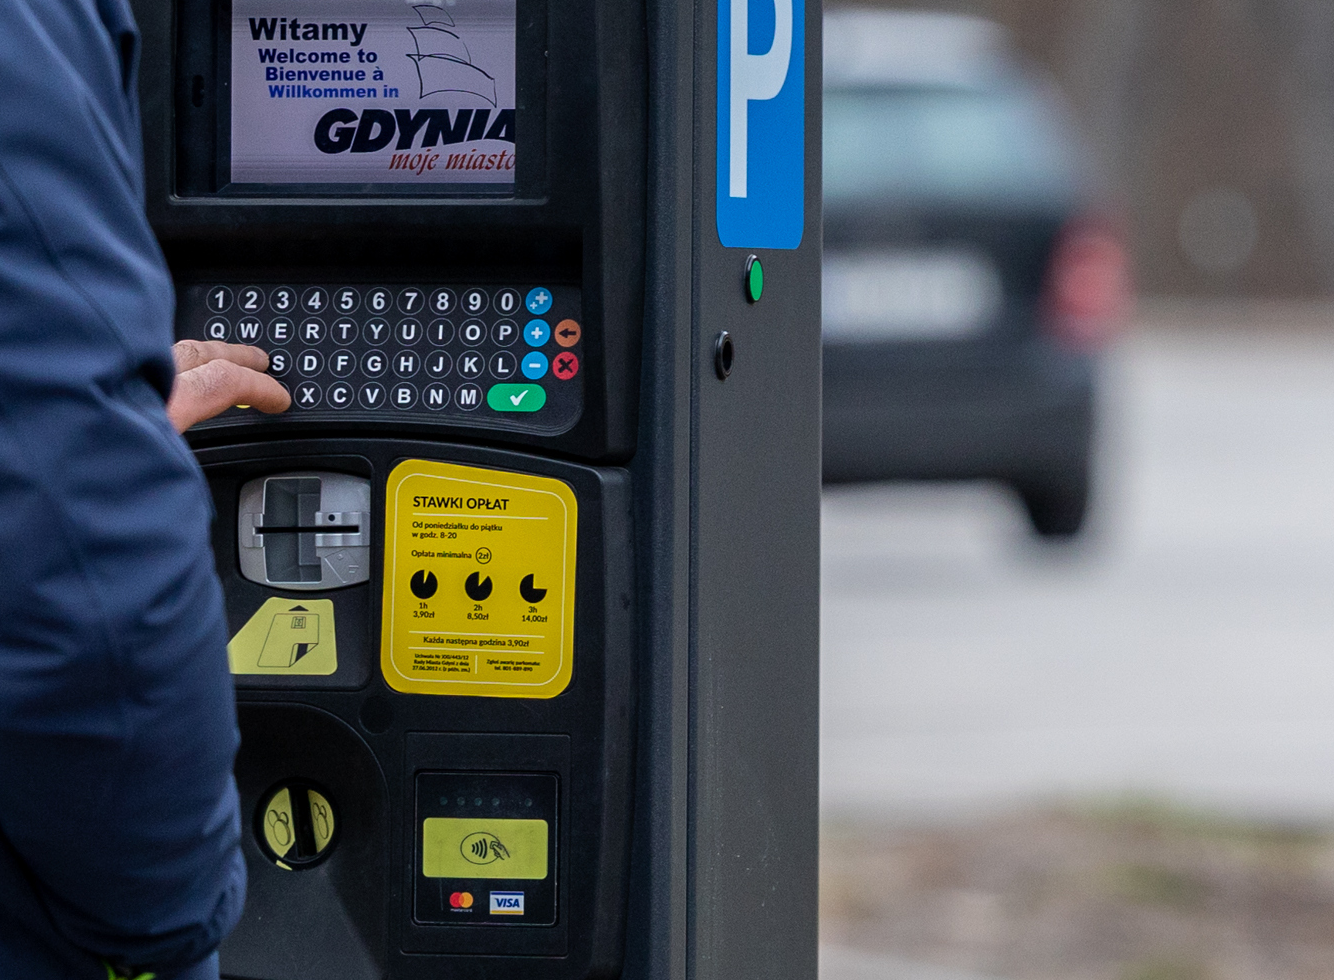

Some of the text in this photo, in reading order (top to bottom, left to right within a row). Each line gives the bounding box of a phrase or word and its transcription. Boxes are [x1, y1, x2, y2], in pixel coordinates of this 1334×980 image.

[248, 17, 368, 47] Witamy
[258, 48, 378, 63] Welcome to
[265, 66, 384, 81] Bienvenue à
[268, 85, 399, 98] Willkommen in
[314, 108, 516, 154] GDYNIA
[388, 148, 516, 175] moje miasto
[215, 290, 514, 311] 1 2 3 4 5 6 7 8 9 0
[210, 322, 512, 341] Q W E R T Y U I O P
[272, 354, 509, 373] S D F G H J K L
[300, 387, 477, 405] X C V B N M
[413, 496, 509, 510] STAWKI OPŁAT
[412, 521, 423, 529] Od
[424, 522, 468, 530] poniedziałku
[481, 524, 503, 532] piątku
[419, 531, 438, 539] godz.
[411, 550, 489, 560] Opłata minimalna 2zł
[413, 611, 435, 619] 3,90zł
[528, 606, 538, 614] 3h
[467, 613, 489, 621] 8,50zł
[521, 615, 548, 623] 14,00zł
[423, 636, 444, 644] Każda
[446, 637, 478, 646] następna
[494, 898, 520, 908] VISA
